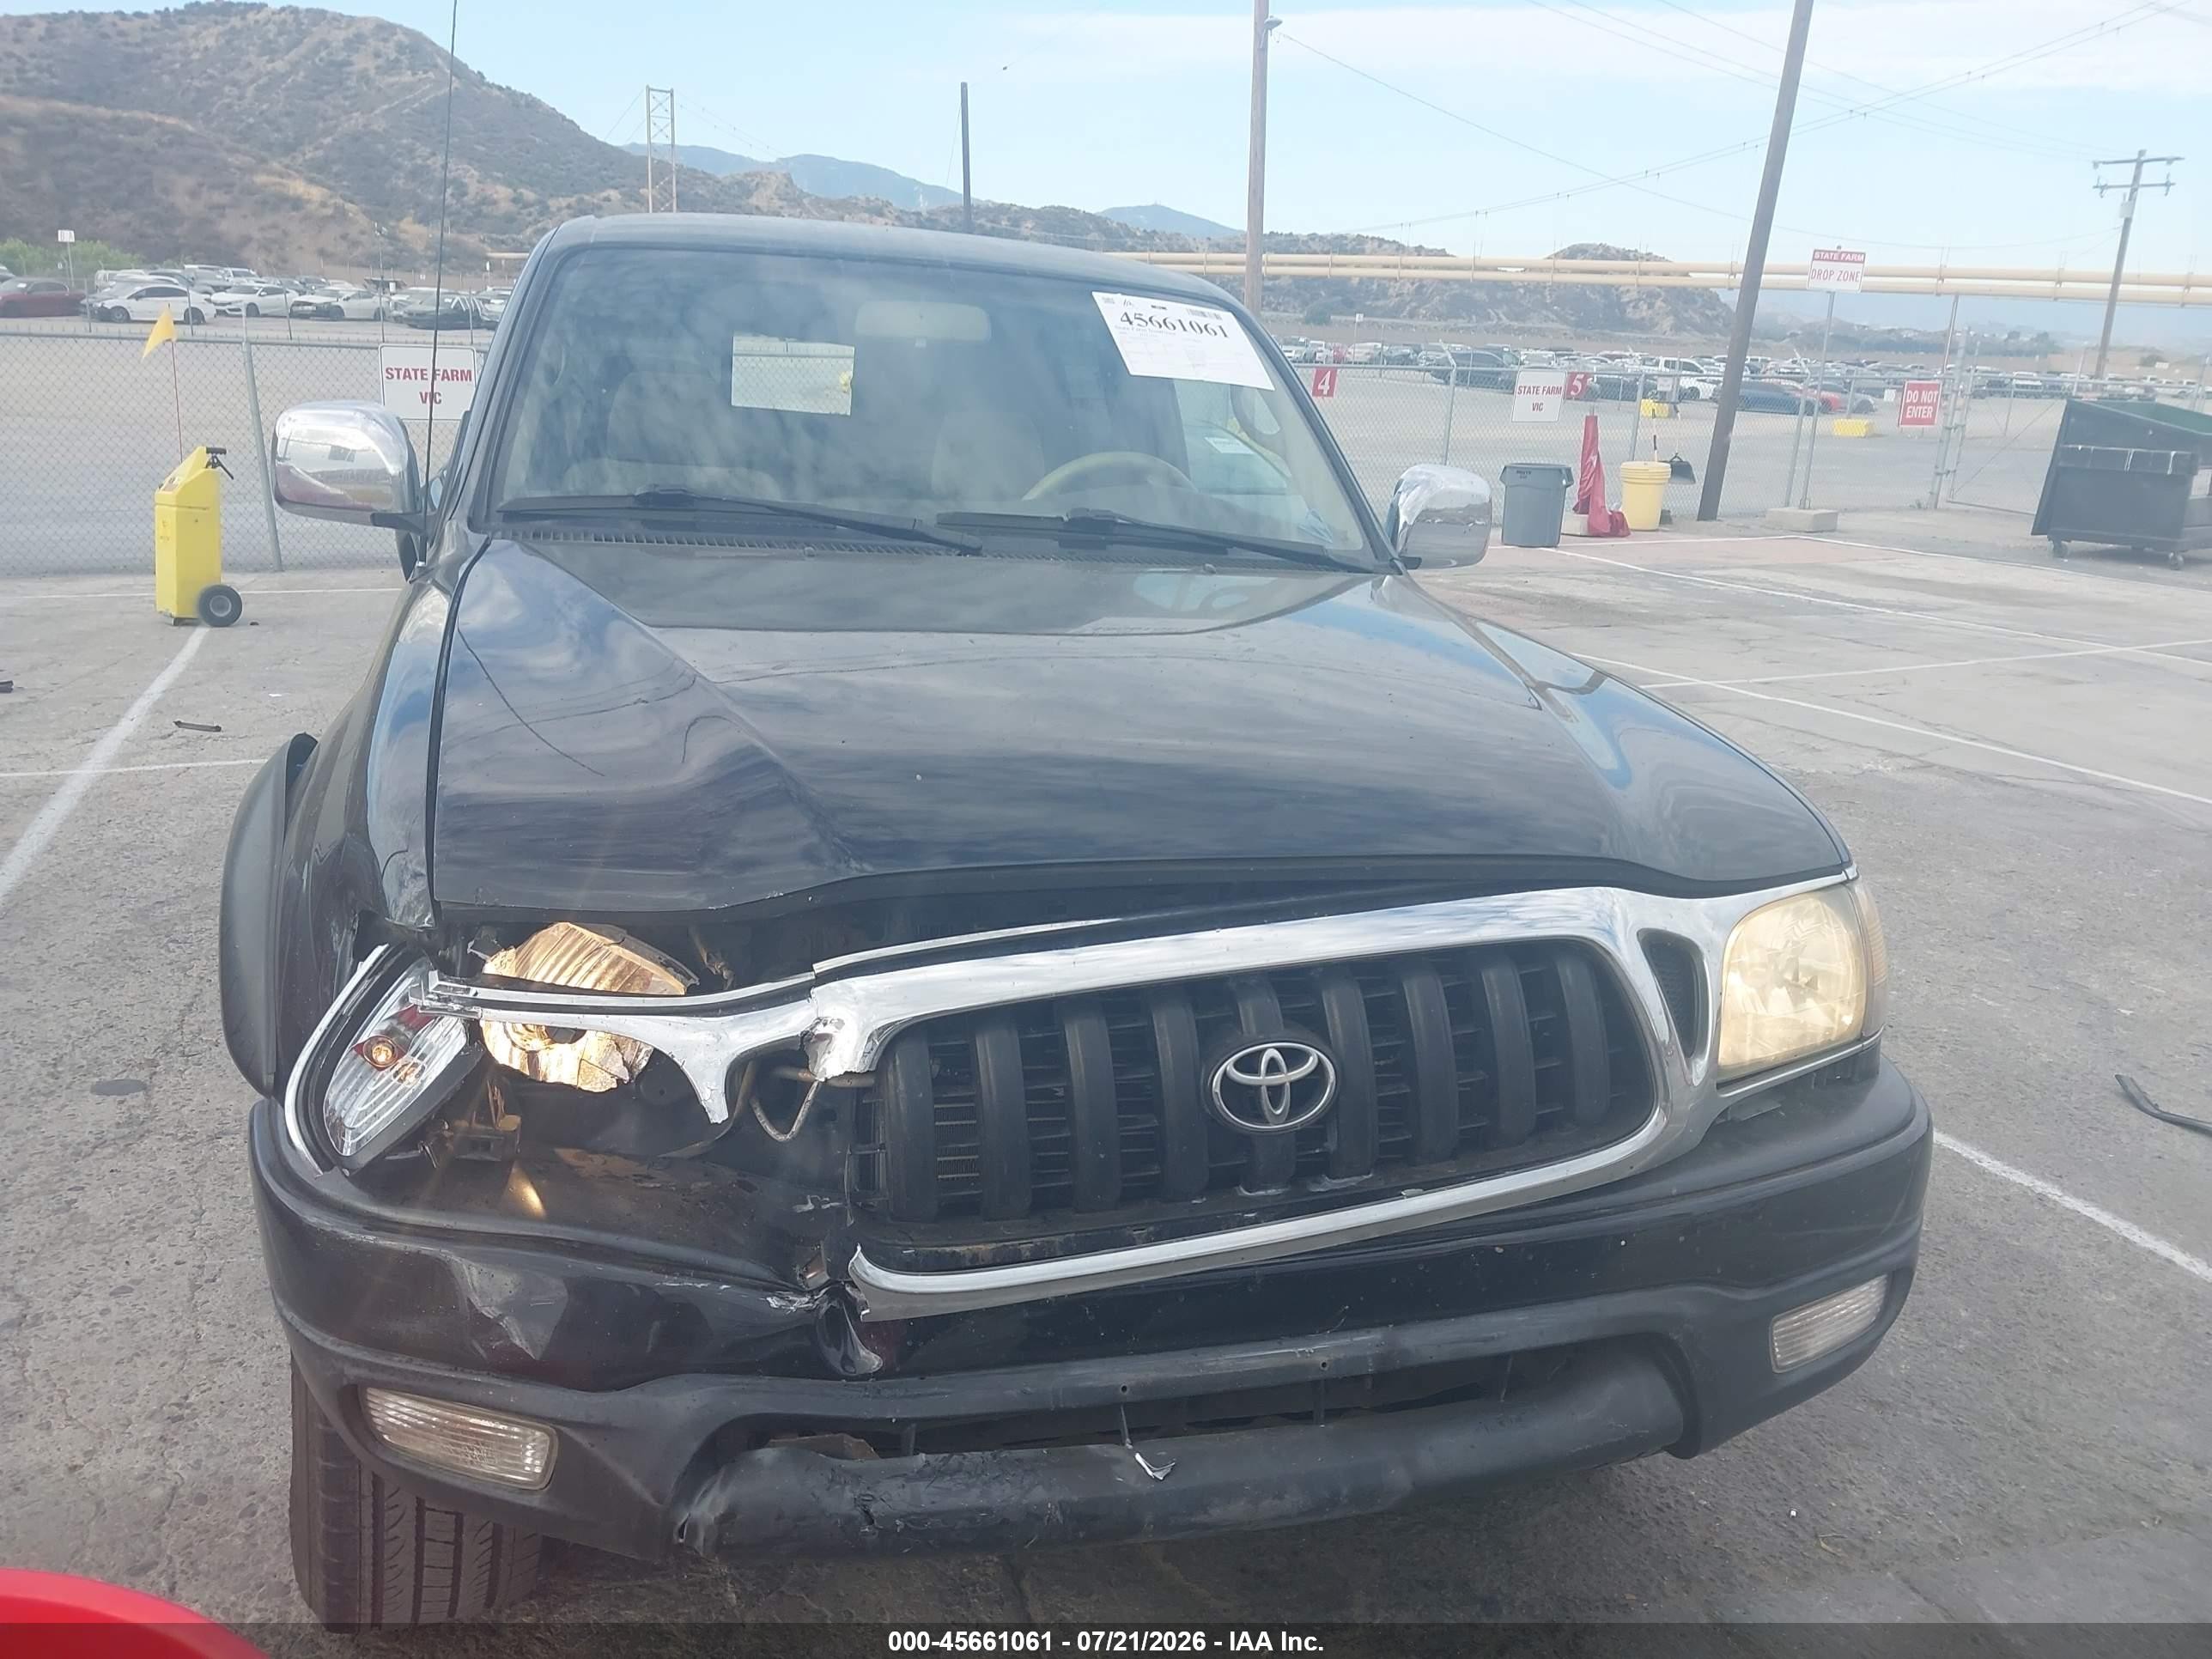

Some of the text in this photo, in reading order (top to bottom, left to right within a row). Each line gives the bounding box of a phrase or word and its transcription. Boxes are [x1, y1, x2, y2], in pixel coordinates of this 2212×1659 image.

[1814, 252, 1863, 262] STATE FARM
[1811, 269, 1861, 282] DROP ZONE
[1120, 311, 1229, 337] 45661061
[385, 367, 472, 381] STATE FARM
[1317, 370, 1331, 395] 4
[1571, 374, 1585, 396] 5
[1517, 385, 1563, 396] STATE FARM
[1906, 390, 1918, 403] DO
[1921, 391, 1939, 404] NOT
[1906, 405, 1934, 419] ENTER
